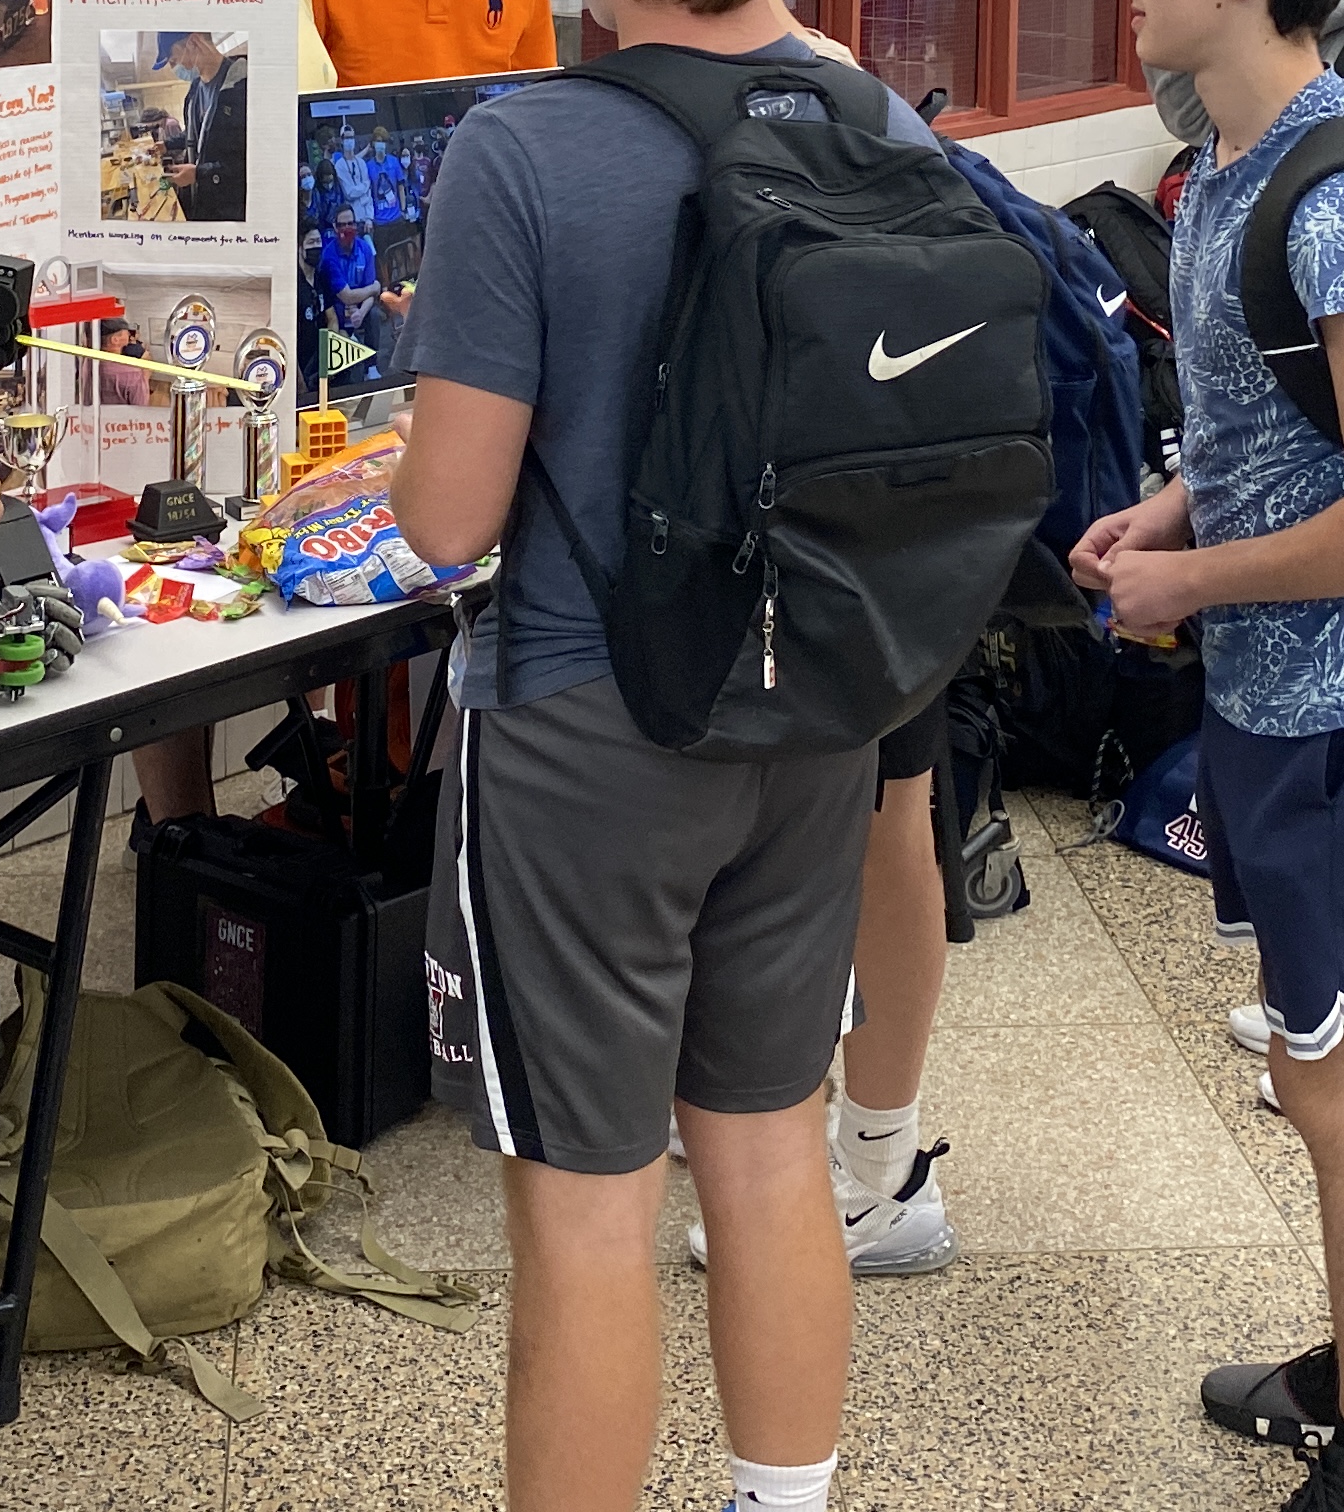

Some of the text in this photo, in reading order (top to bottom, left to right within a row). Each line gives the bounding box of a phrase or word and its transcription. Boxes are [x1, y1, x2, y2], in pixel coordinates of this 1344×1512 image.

[27, 85, 56, 107] You?
[67, 228, 105, 239] Members
[150, 233, 163, 241] on
[219, 236, 233, 247] for
[104, 418, 153, 437] creating
[156, 421, 166, 432] a
[166, 492, 196, 507] GNCE
[300, 505, 396, 562] RIBO
[218, 918, 255, 953] GNCE
[424, 951, 463, 1000] TON
[430, 1037, 474, 1063] BALL
